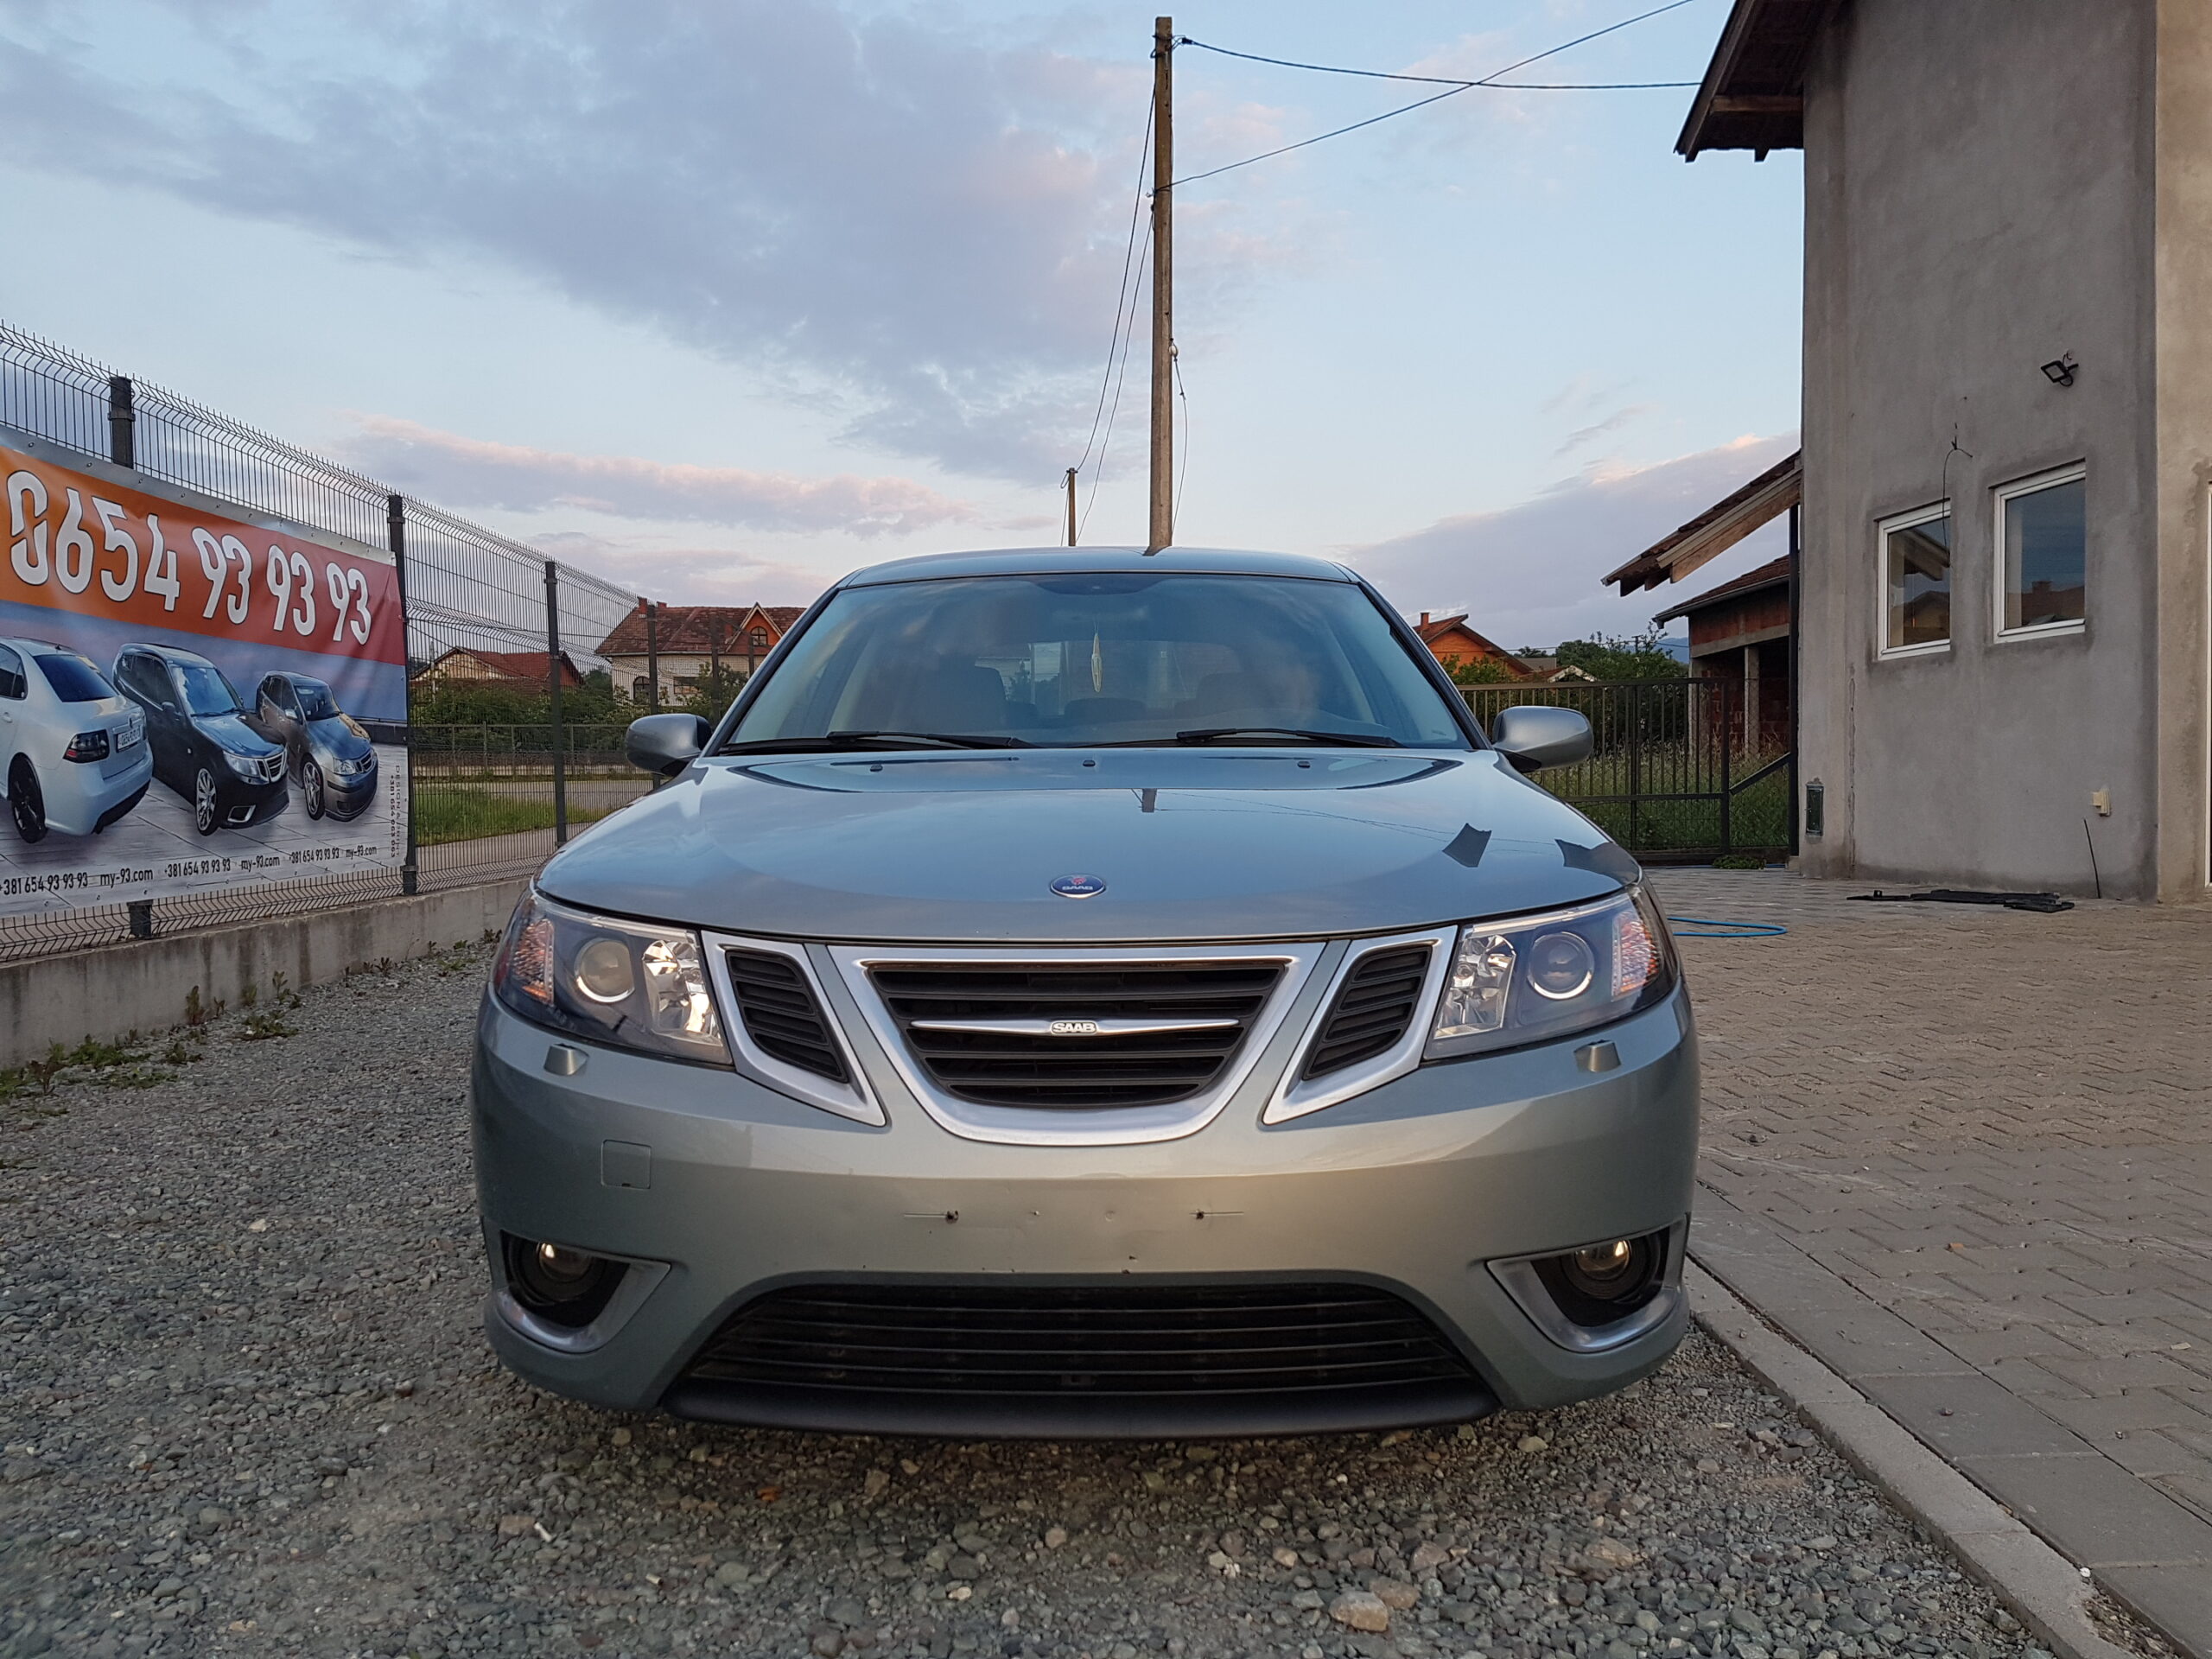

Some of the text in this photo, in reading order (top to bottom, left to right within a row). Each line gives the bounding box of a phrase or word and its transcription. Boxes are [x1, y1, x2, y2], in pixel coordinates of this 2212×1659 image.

[7, 470, 372, 645] 0654 93 93 93
[24, 875, 44, 893] 654
[47, 874, 60, 891] 93
[62, 873, 74, 890] 93
[77, 872, 88, 888] 93
[99, 868, 154, 888] my-93.com
[164, 862, 181, 878] +381
[183, 861, 199, 876] 654
[200, 860, 209, 874] 93
[212, 859, 220, 874] 93
[222, 857, 231, 872] 93
[241, 855, 281, 873] my-93.com
[302, 849, 315, 863] 654
[315, 849, 323, 861] 93
[324, 848, 331, 860] 93
[332, 847, 340, 859] 93
[346, 845, 378, 860] my-93.com
[1052, 1022, 1096, 1033] SAAB
